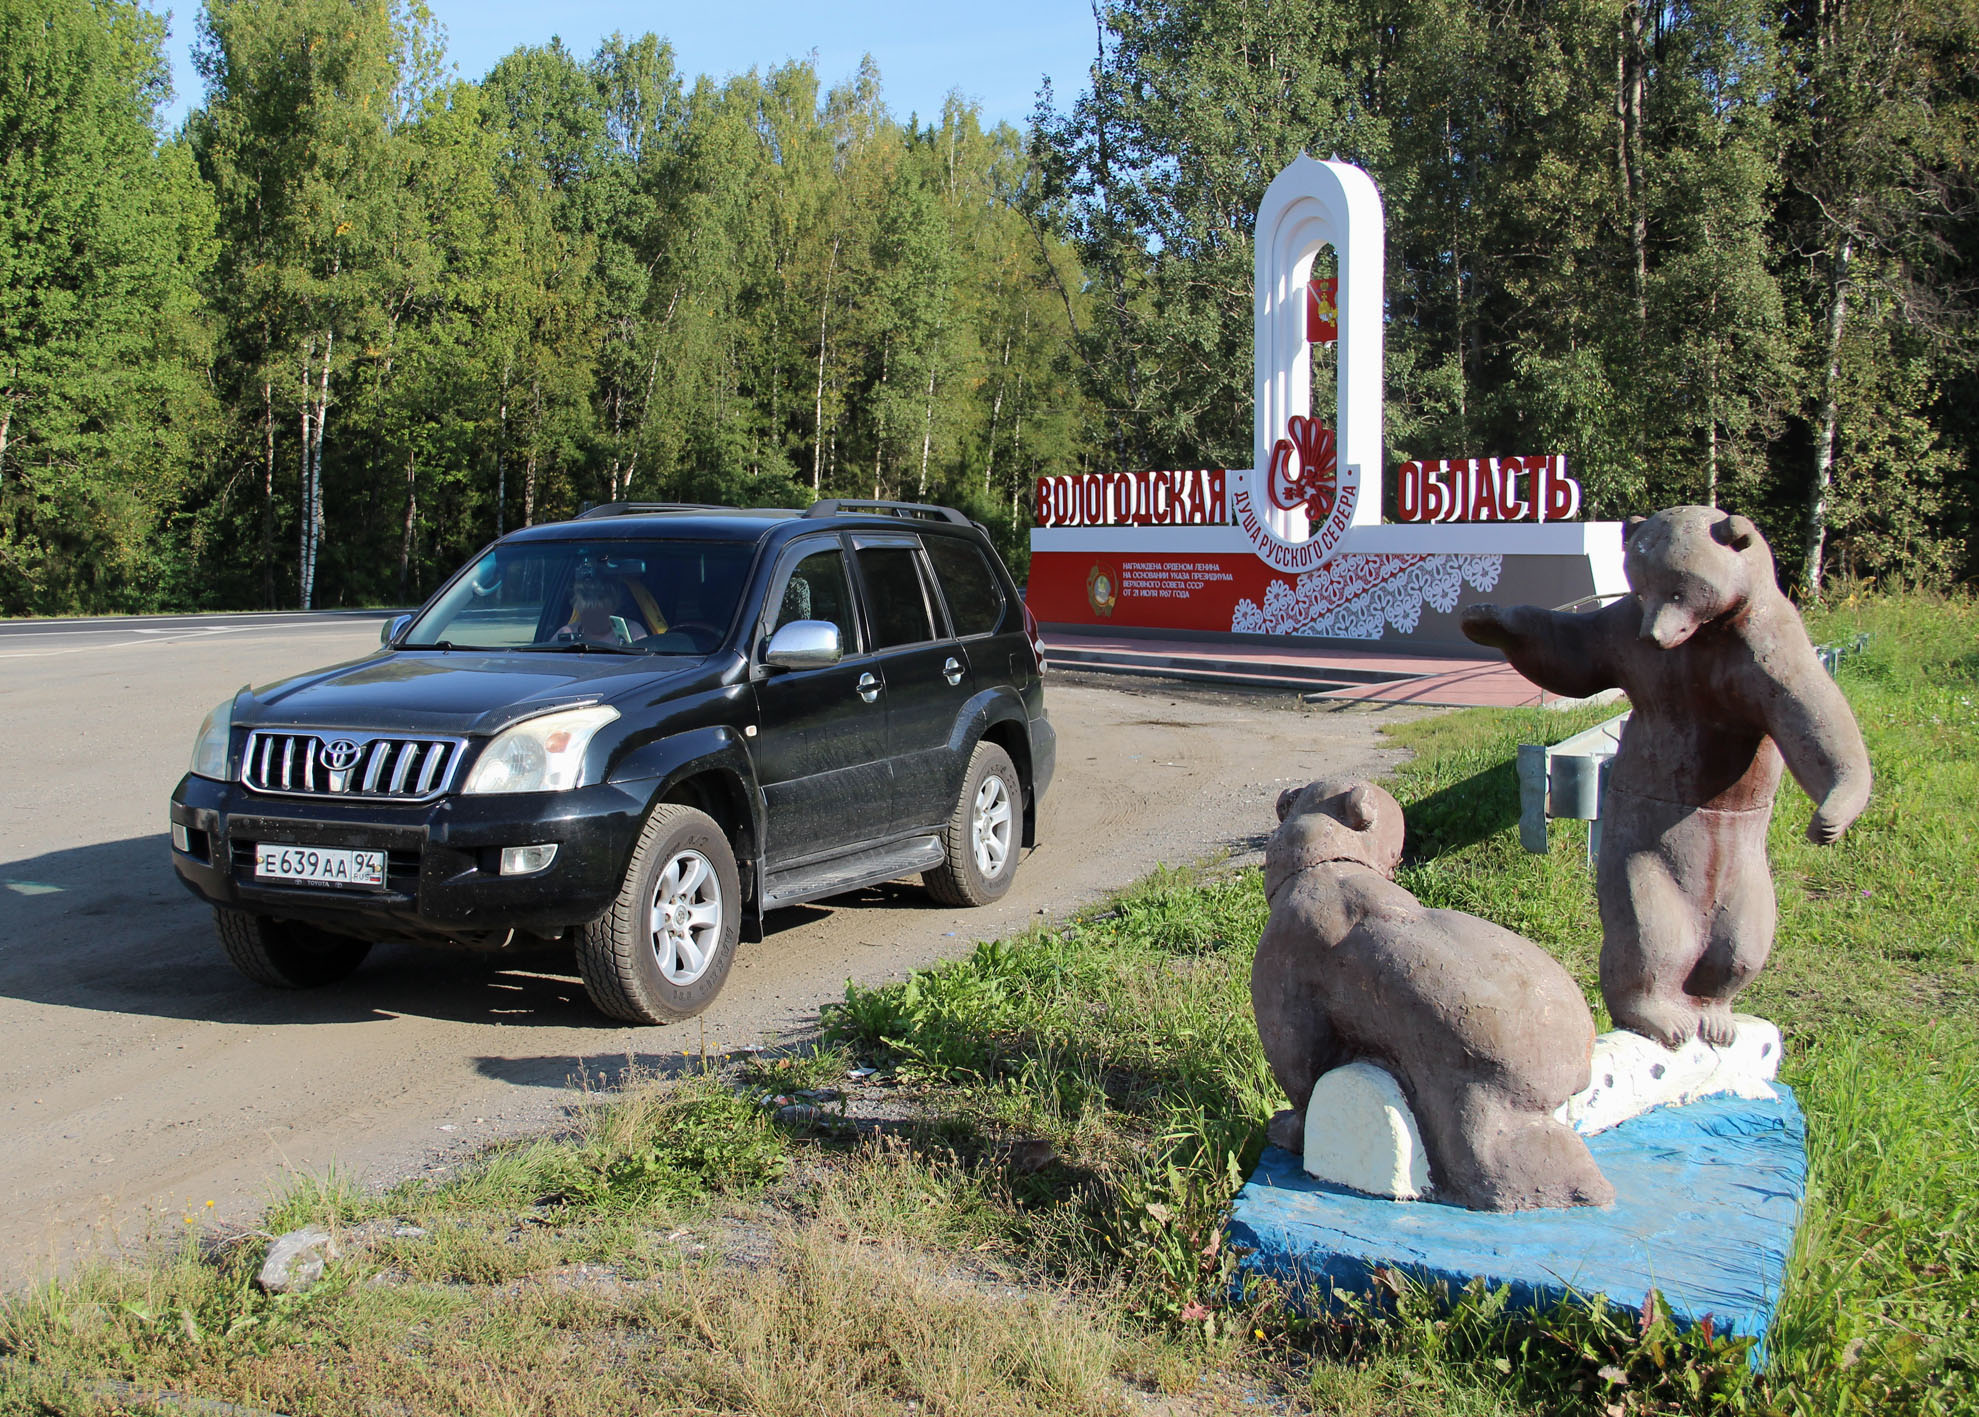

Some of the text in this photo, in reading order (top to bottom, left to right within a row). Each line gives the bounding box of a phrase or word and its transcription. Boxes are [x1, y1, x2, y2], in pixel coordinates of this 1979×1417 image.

[1037, 455, 1580, 526] ВОЛОГОДСКАЯ ОБЛАСТЬ
[1234, 485, 1357, 568] ДУША РУССКОГО СЕВЕРА
[1163, 563, 1193, 571] ОРДЕНОМ
[1123, 571, 1233, 581] НА ОСНОВАНИИ УКАЗА ПРЕЗИДИУМА
[1123, 580, 1161, 588] ВЕРХОВНОГО
[1161, 580, 1185, 589] СОВЕТА
[1123, 589, 1131, 597] ОТ
[1140, 589, 1158, 597] ИЮЛЯ
[1172, 590, 1190, 598] ГОДА
[355, 853, 376, 873] 94
[353, 872, 370, 880] RUS
